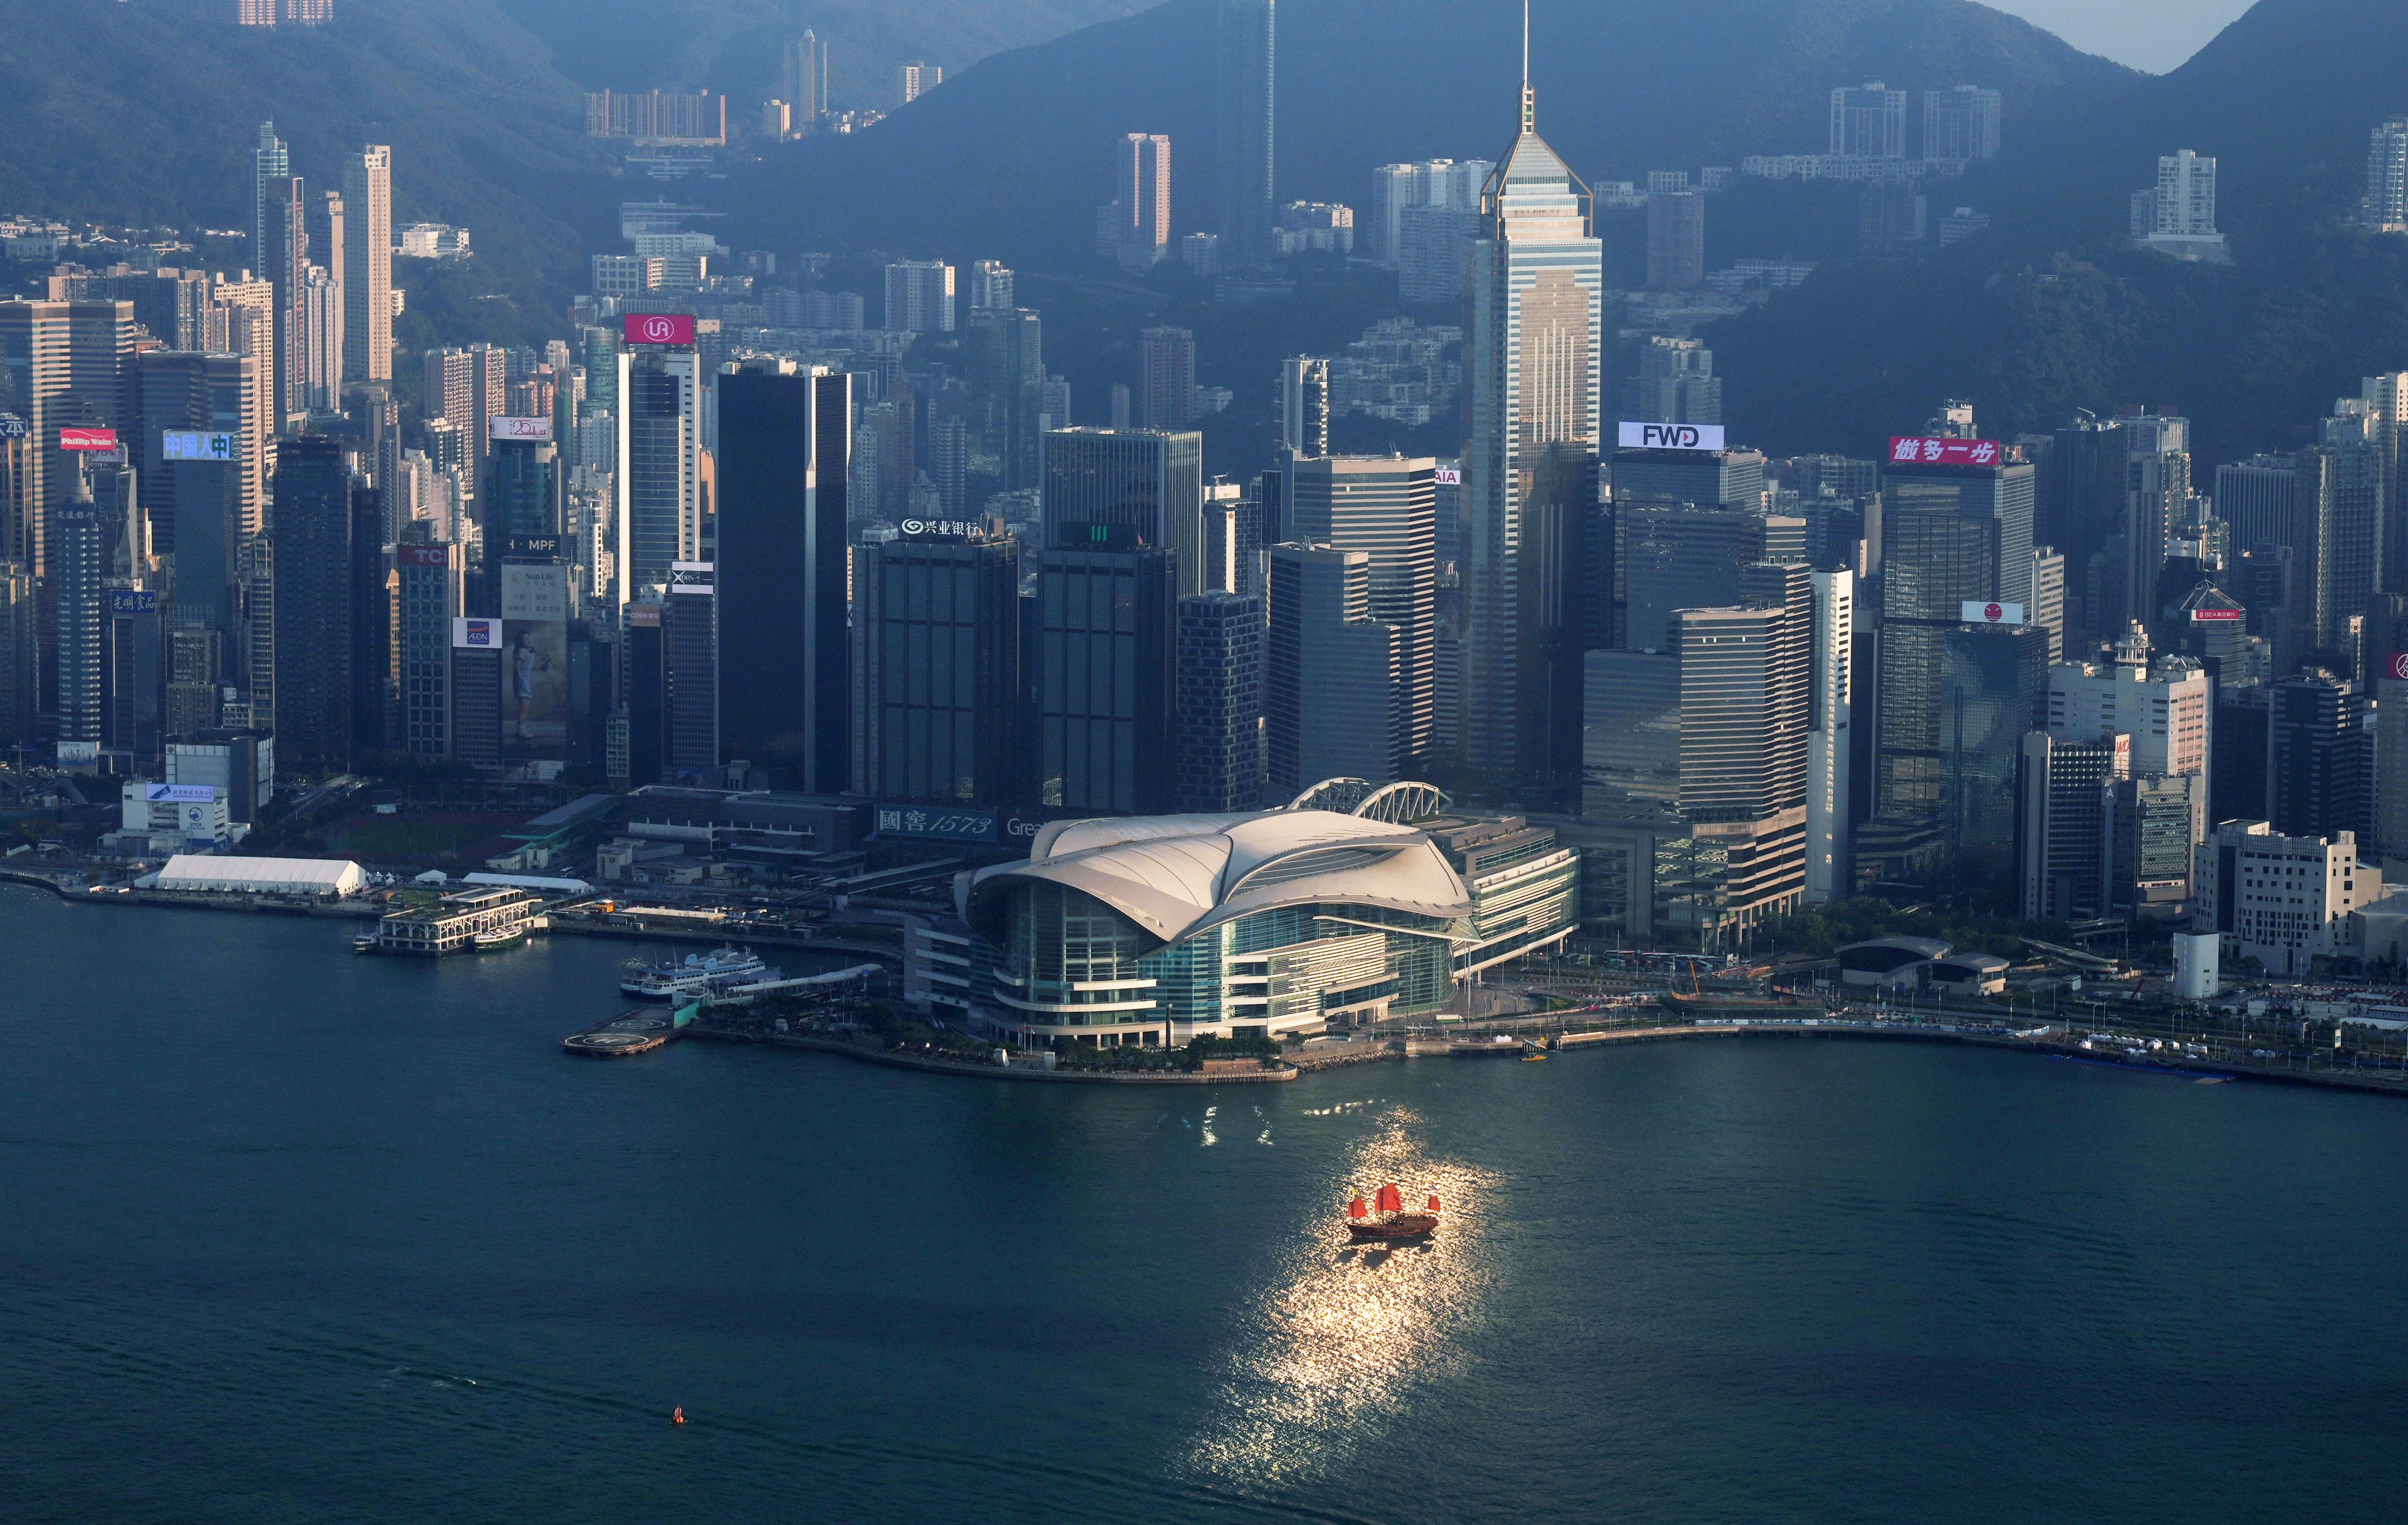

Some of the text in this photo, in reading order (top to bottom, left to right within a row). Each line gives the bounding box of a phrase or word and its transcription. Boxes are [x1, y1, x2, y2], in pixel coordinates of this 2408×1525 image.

[61, 437, 111, 446] Phillip Wain
[1643, 425, 1699, 447] FWD
[1894, 439, 1995, 463] 做多一步
[1434, 471, 1456, 482] AIA
[58, 510, 95, 523] 交通銀行
[924, 520, 978, 536] 兴业银行
[529, 540, 556, 550] MPF
[113, 594, 155, 610] 光明食品
[928, 816, 992, 834] 1573
